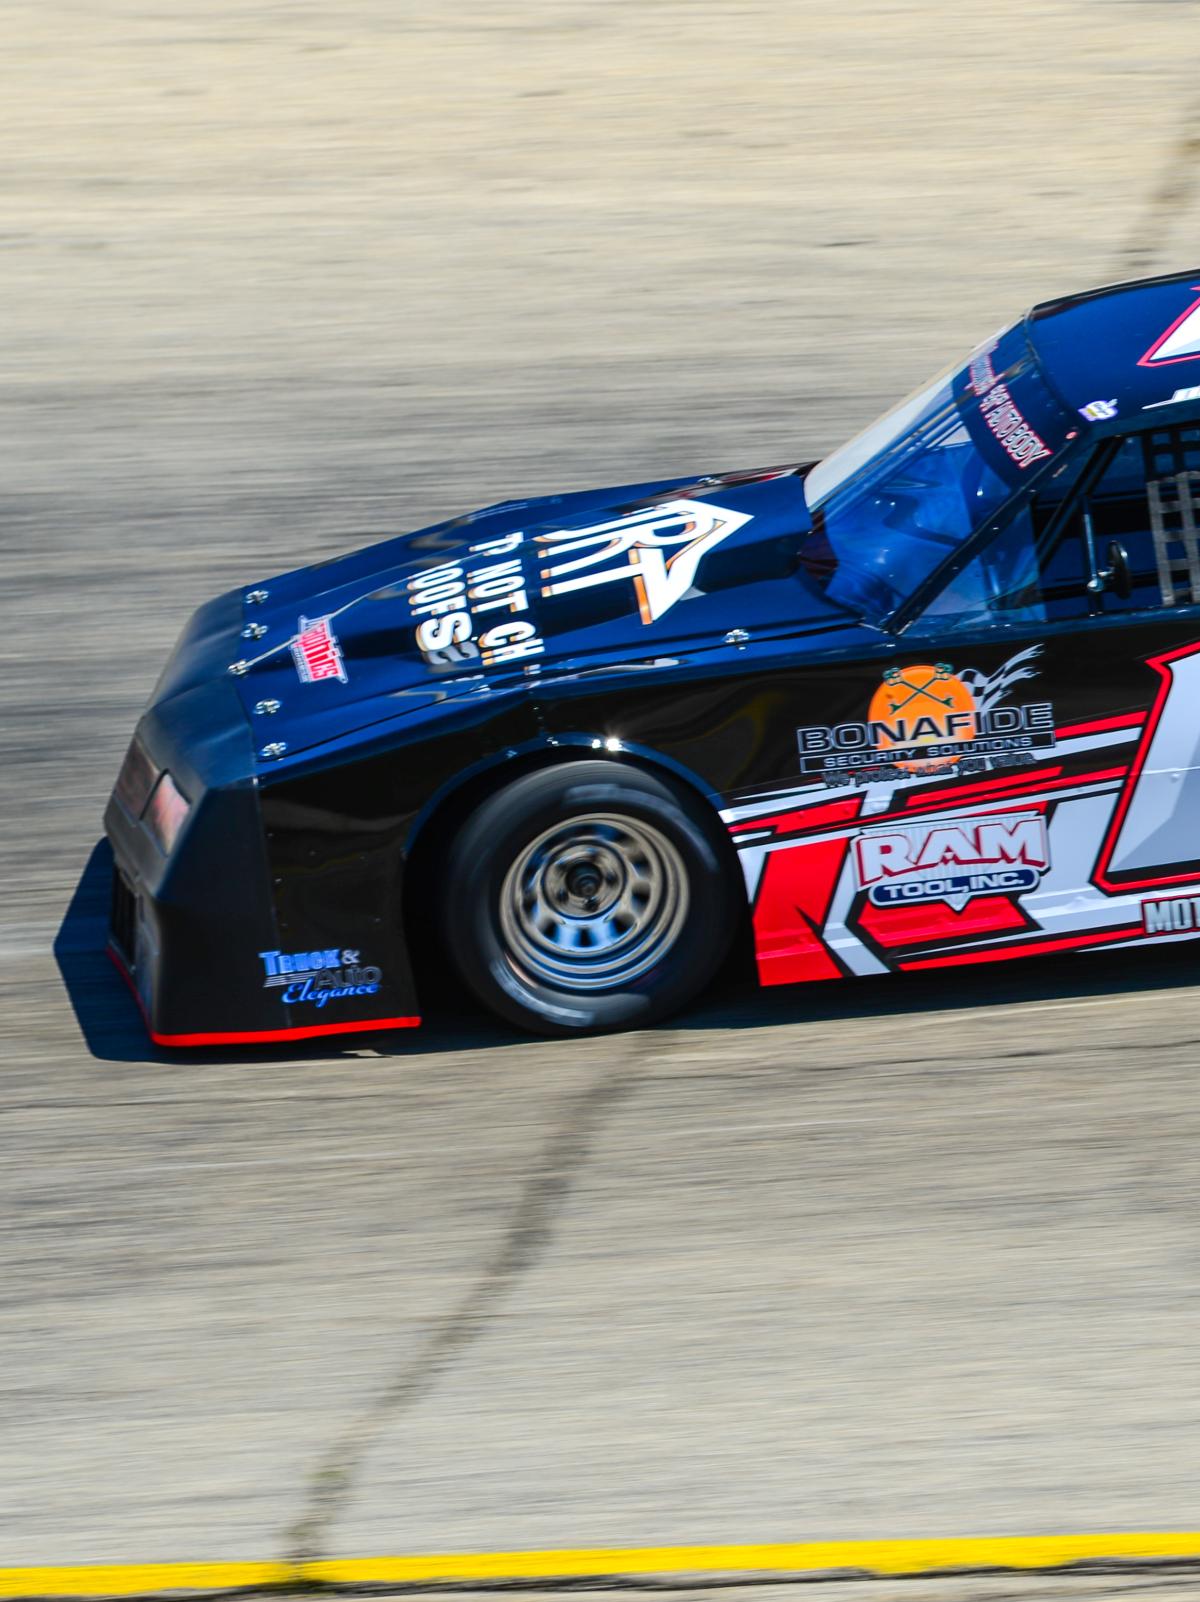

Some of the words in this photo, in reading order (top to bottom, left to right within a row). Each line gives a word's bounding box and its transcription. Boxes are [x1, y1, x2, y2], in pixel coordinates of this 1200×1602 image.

[1001, 423, 1053, 468] BODY
[798, 703, 1053, 753] BONAFIDE
[823, 752, 914, 768] SECURITY
[926, 736, 1033, 757] SOLUTIONS
[856, 818, 1046, 886] RAM
[341, 950, 360, 965] &
[281, 978, 382, 1008] Elegance
